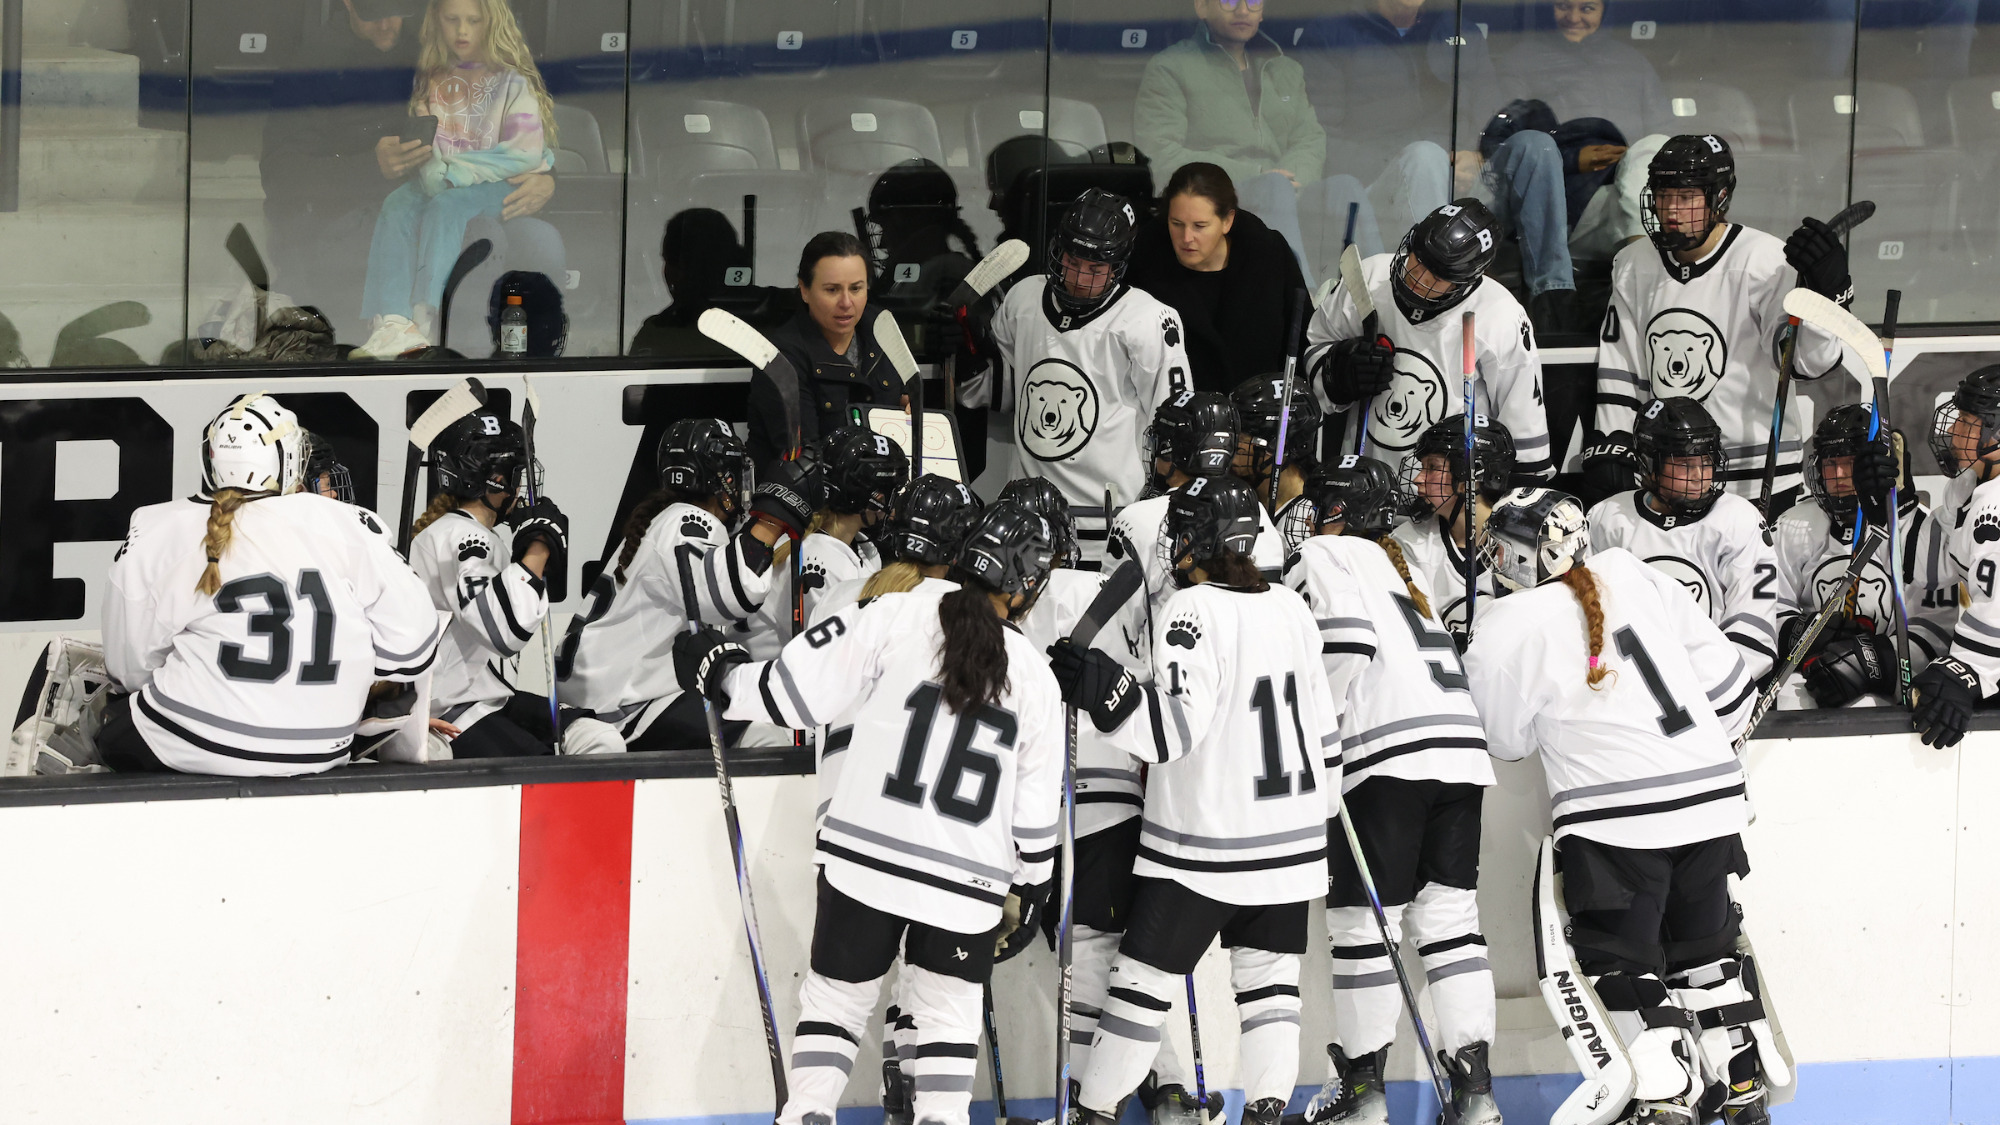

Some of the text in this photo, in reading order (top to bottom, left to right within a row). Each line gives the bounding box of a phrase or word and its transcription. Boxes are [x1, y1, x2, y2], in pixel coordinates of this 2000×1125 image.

[1639, 24, 1648, 36] 9
[249, 37, 256, 49] 1
[609, 35, 619, 48] 3
[785, 33, 795, 45] 4
[960, 33, 969, 45] 5
[1130, 33, 1139, 44] 6
[1702, 135, 1723, 154] B
[1122, 203, 1136, 226] B
[1438, 204, 1463, 217] B
[1476, 228, 1493, 253] B
[1883, 243, 1899, 255] 10
[733, 270, 743, 283] 3
[902, 266, 912, 278] 4
[1681, 266, 1690, 279] B
[1059, 315, 1072, 329] B
[1410, 308, 1424, 321] B
[1173, 390, 1195, 408] B
[1644, 399, 1665, 419] B
[481, 415, 501, 436] B
[714, 418, 733, 438] B
[1475, 413, 1490, 428] B
[873, 435, 890, 456] B
[1208, 453, 1225, 466] 27
[1338, 454, 1360, 469] B
[671, 472, 684, 485] 19
[955, 484, 971, 505] B
[1186, 477, 1208, 497] B
[1387, 512, 1393, 525] 5
[1663, 516, 1677, 527] B
[1842, 528, 1854, 541] B
[906, 537, 924, 553] 22
[1238, 540, 1246, 552] 11
[973, 556, 990, 572] 16
[213, 567, 341, 686] 31
[1391, 590, 1470, 694] 5
[1612, 624, 1697, 739] 1
[1249, 671, 1316, 801] 11
[881, 680, 1020, 827] 16
[1062, 977, 1072, 1042] BAUER
[1553, 970, 1612, 1070] VAUGHN
